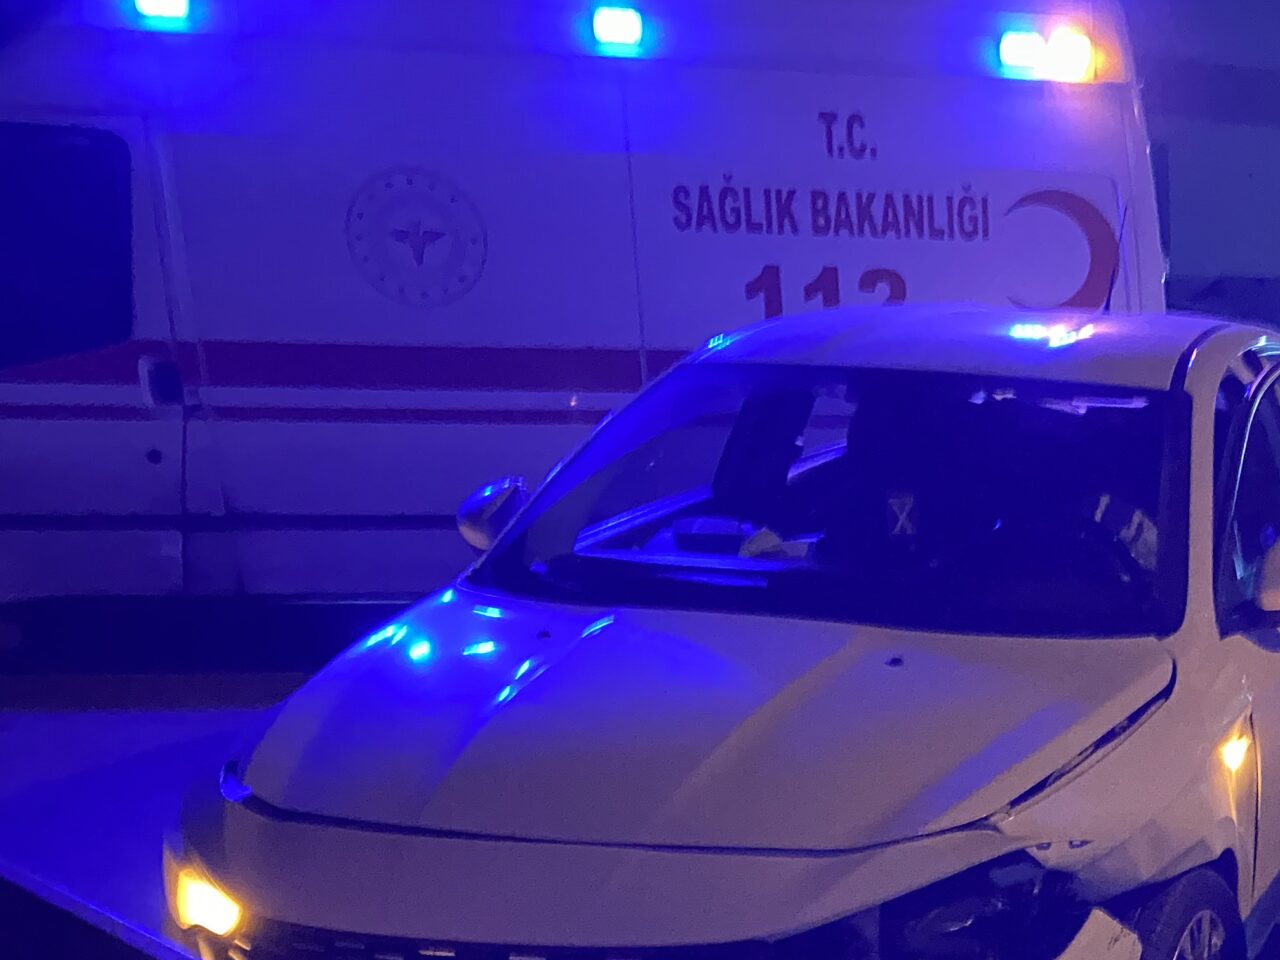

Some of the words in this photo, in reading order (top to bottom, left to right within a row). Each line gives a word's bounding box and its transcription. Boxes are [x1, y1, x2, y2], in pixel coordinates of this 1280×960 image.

[817, 111, 878, 160] T.C.
[672, 174, 799, 234] SAĞLIK
[810, 183, 990, 242] BAKANLIĞI
